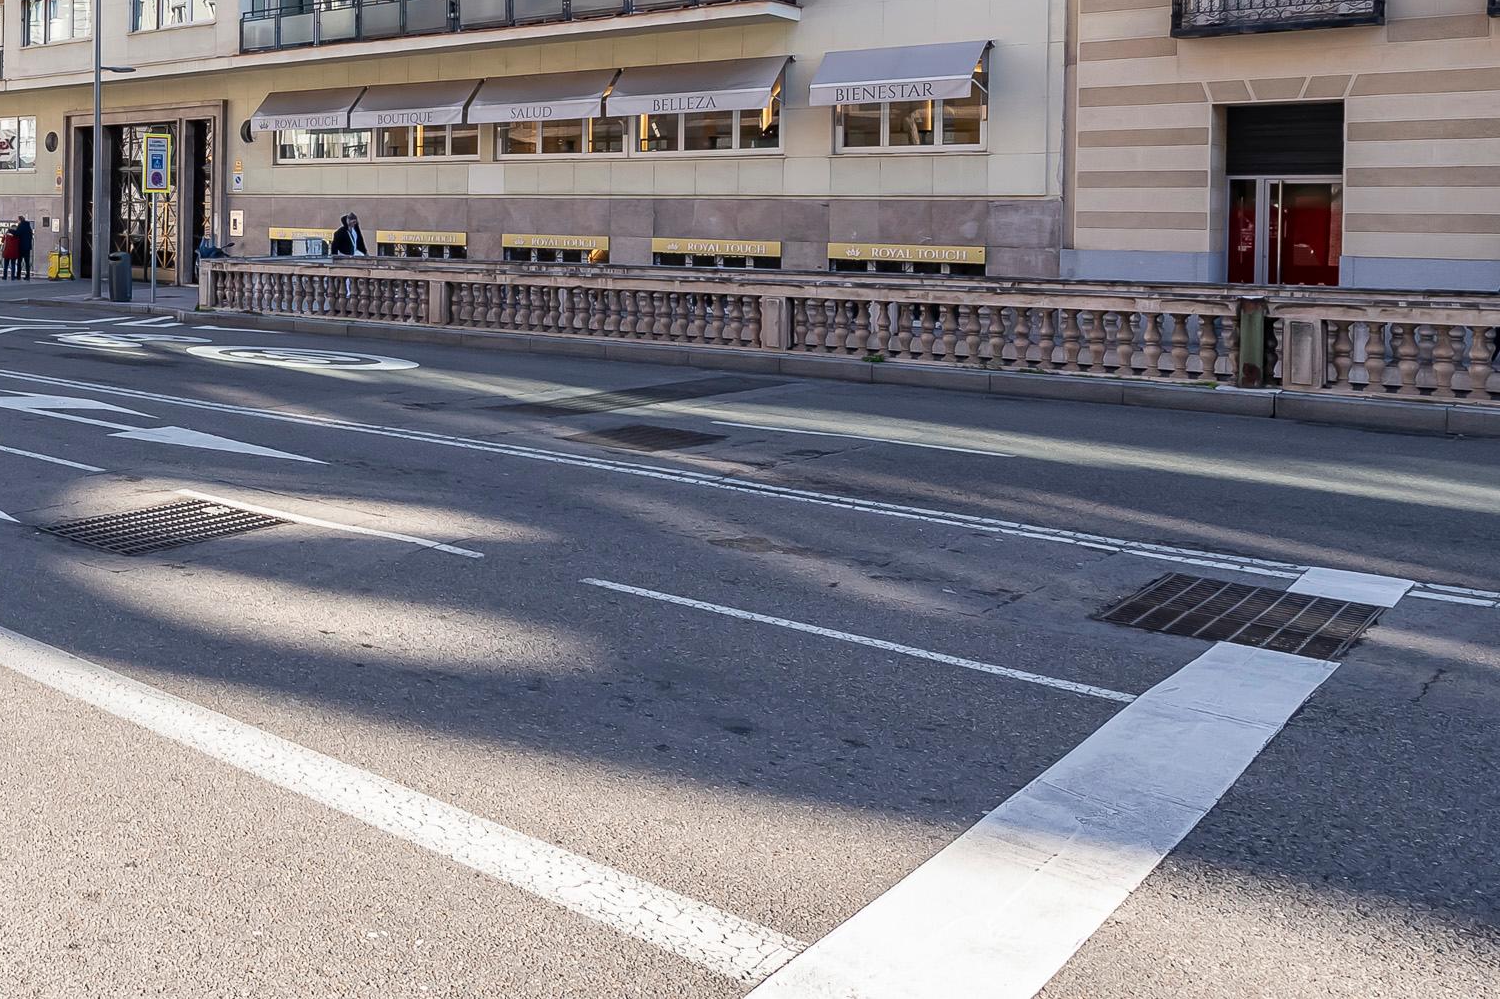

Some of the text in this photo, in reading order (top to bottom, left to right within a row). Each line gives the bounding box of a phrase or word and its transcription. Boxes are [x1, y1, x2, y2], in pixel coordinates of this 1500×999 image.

[835, 82, 934, 102] BIENESTAR
[653, 96, 717, 112] BELLEZA
[377, 112, 433, 125] BOUTIQUE
[510, 106, 552, 119] SALUD
[274, 116, 338, 129] ROYAL TOUCH
[531, 237, 596, 248] ROYAL TOUCH
[687, 242, 766, 254] ROYAL TOUCH
[871, 247, 968, 261] ROYAL TOUCH
